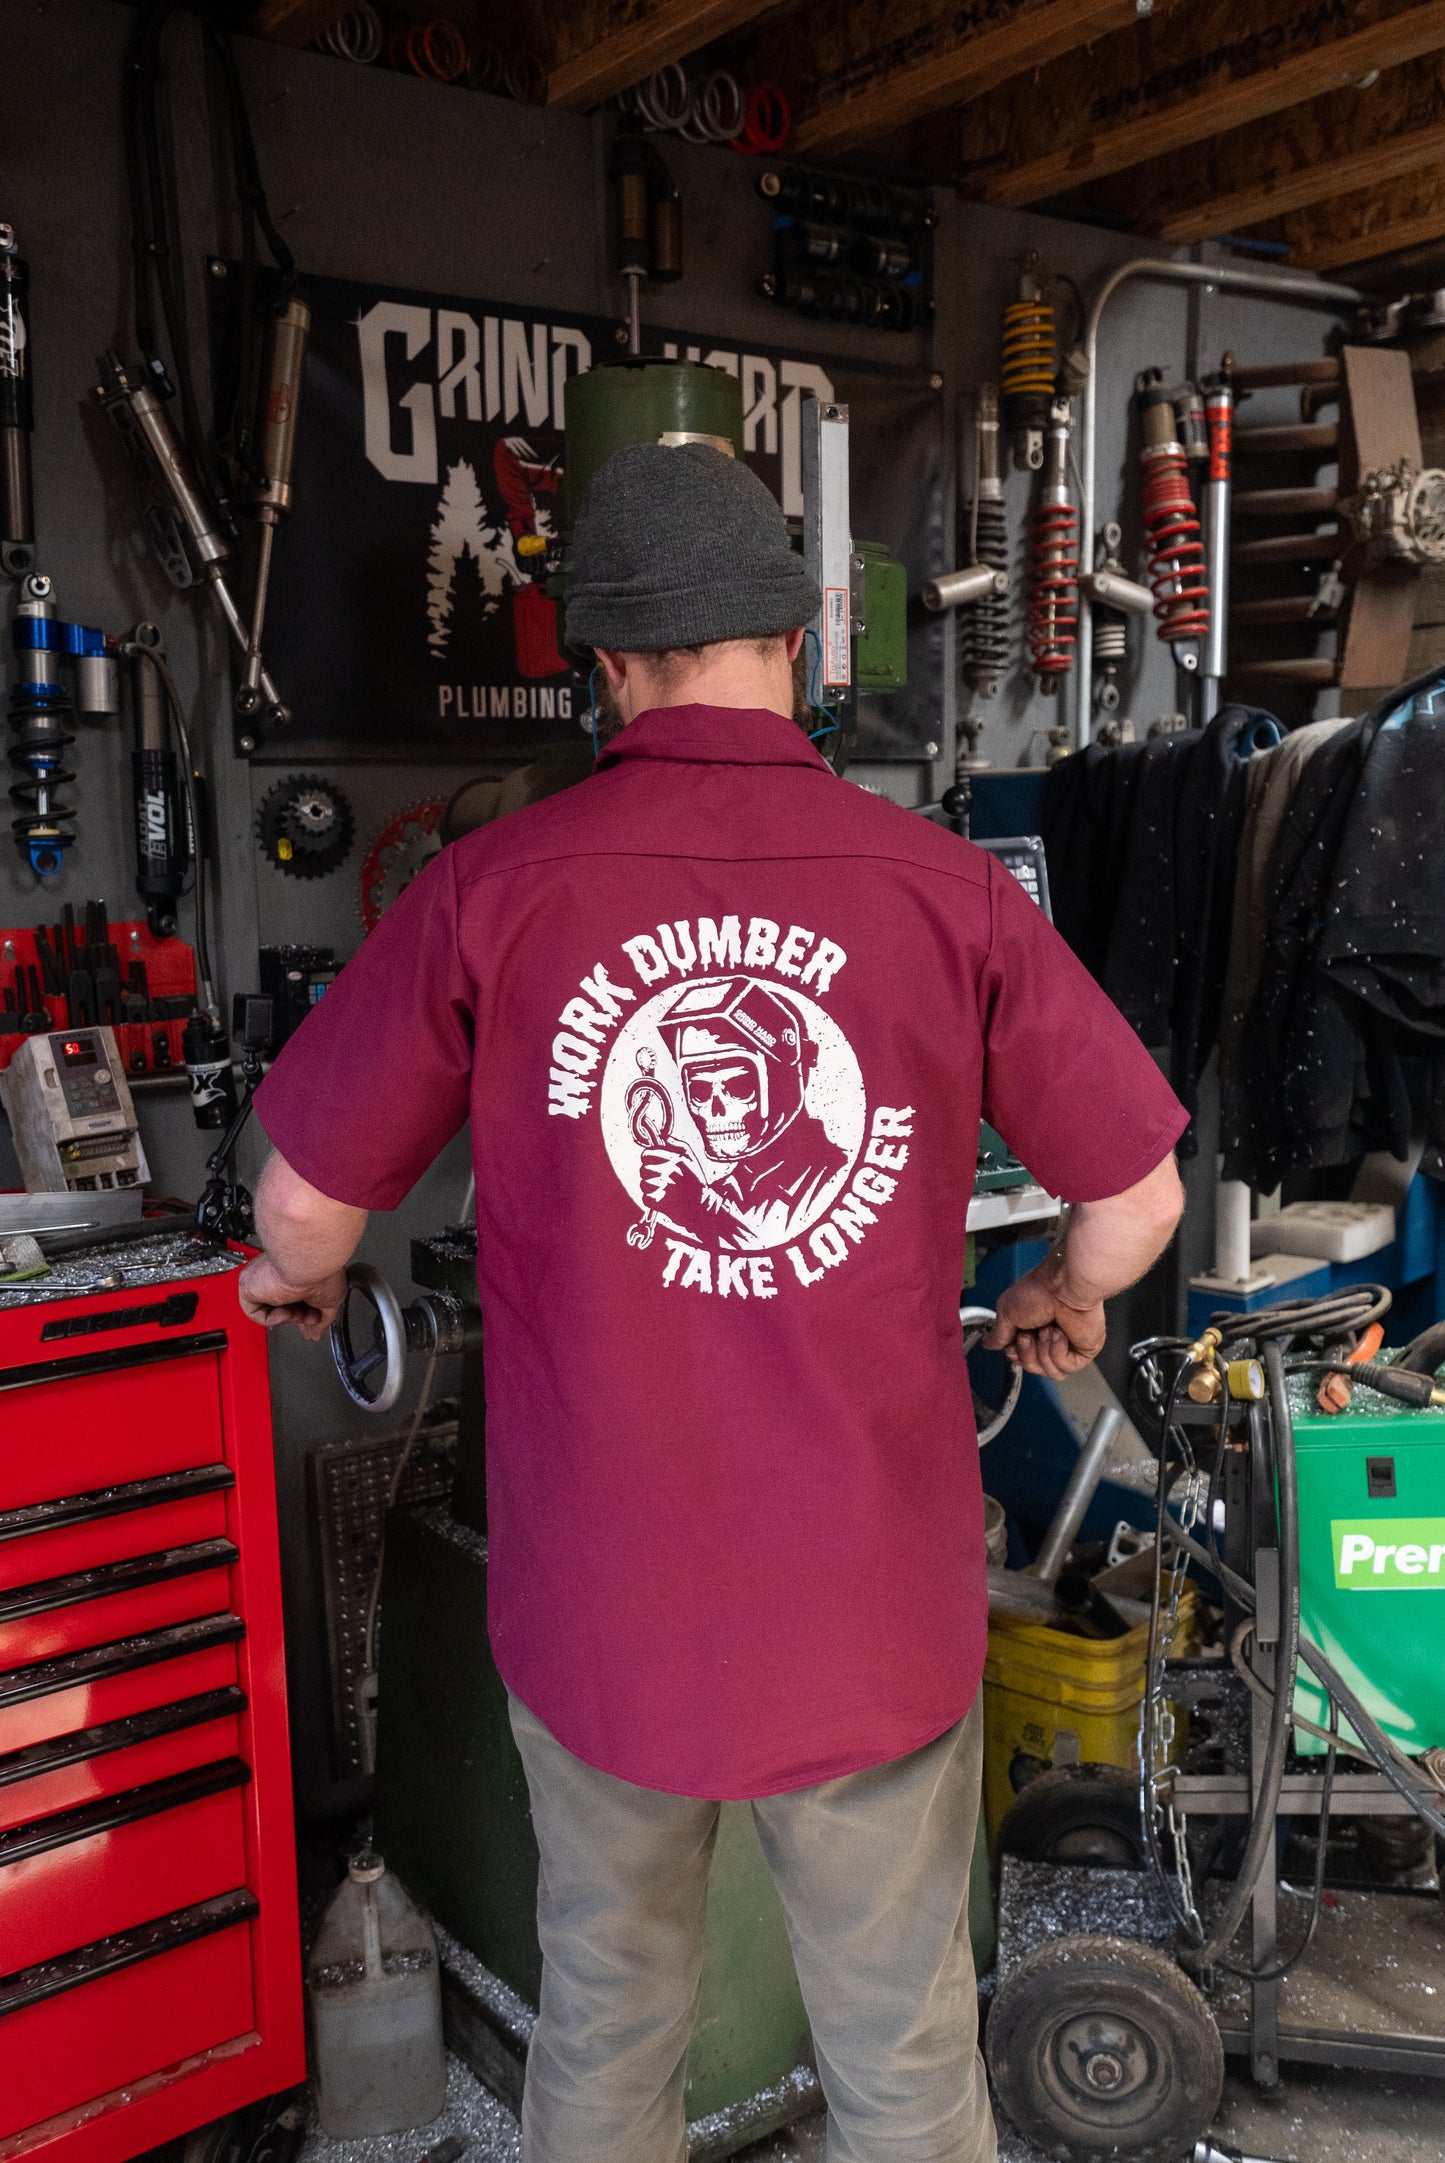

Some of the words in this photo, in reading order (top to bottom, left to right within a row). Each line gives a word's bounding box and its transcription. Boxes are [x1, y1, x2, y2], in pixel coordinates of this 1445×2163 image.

[438, 684, 573, 719] PLUMBING
[139, 800, 149, 857] FLOAT
[548, 962, 637, 1119] WORK
[622, 914, 847, 996] DUMBER
[662, 1238, 778, 1300] TAKE
[785, 1105, 917, 1287] LONGER
